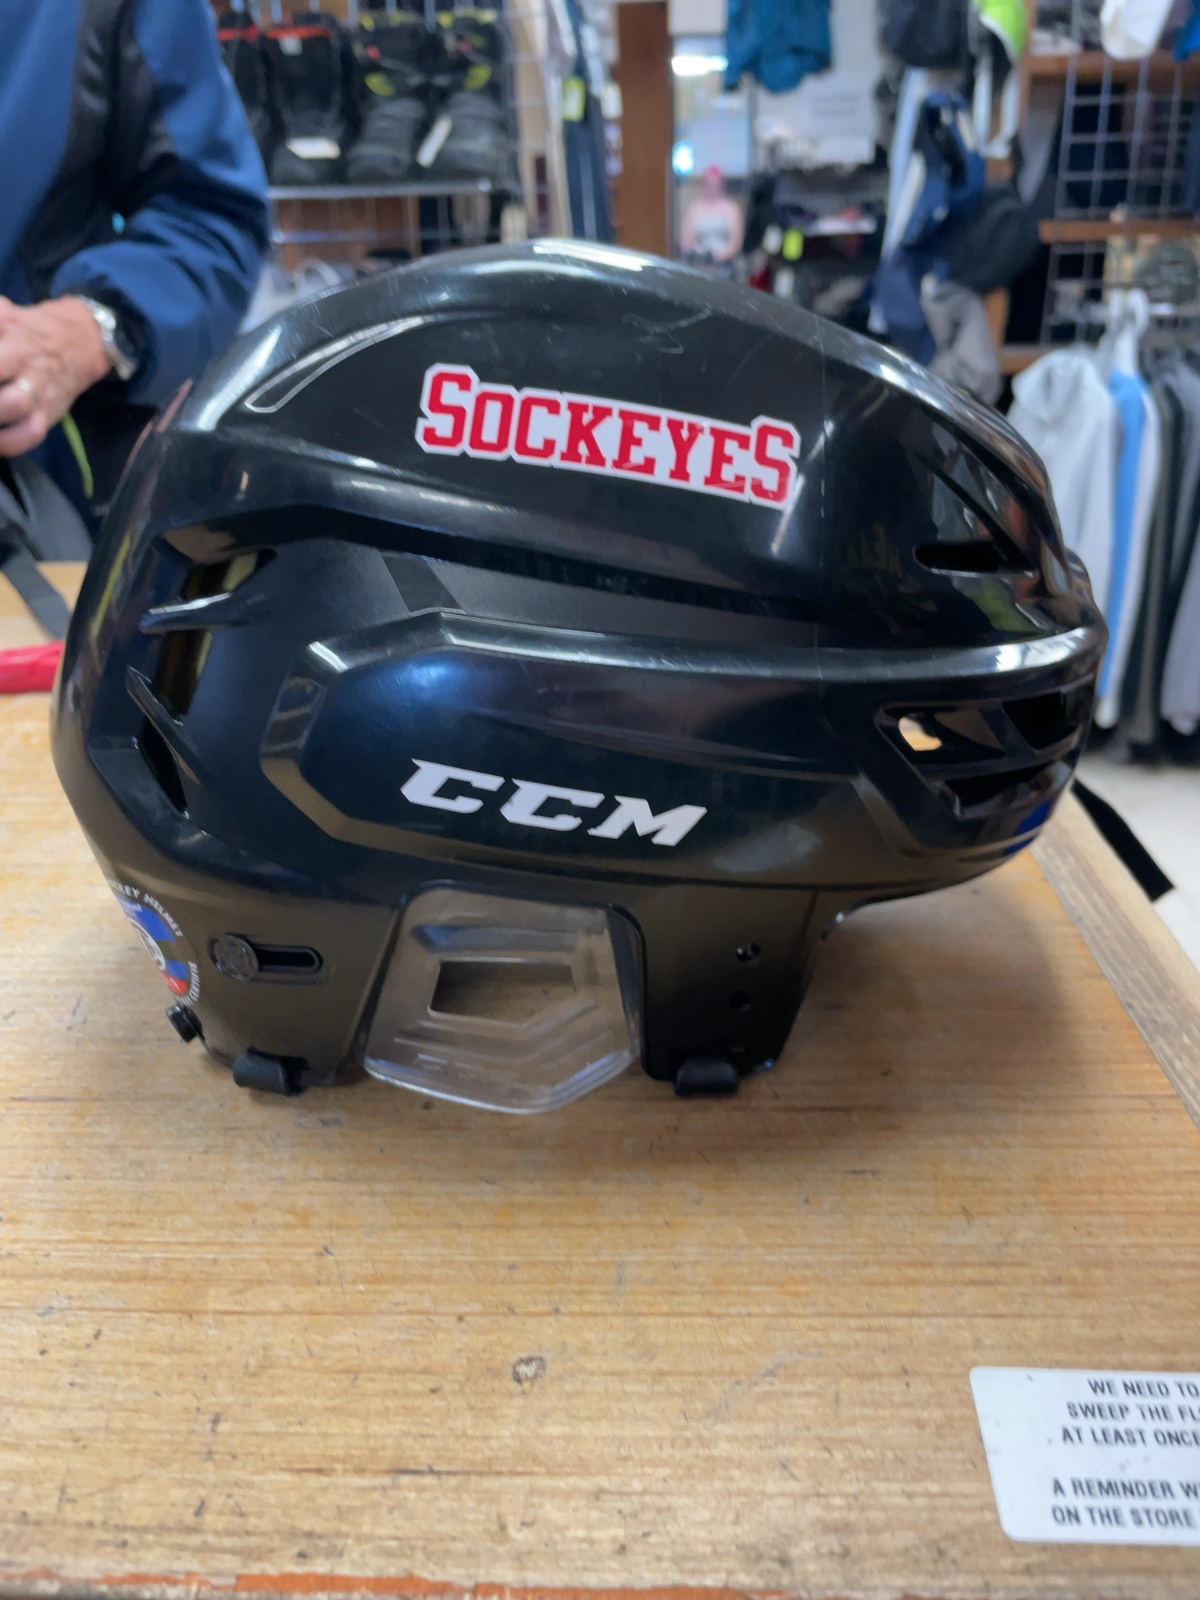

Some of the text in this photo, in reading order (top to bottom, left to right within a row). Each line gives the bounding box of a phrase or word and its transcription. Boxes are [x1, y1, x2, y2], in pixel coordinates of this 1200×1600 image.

[417, 365, 798, 507] SOCKEYES
[400, 758, 708, 847] CCM
[143, 892, 184, 937] HELMET
[1087, 1378, 1200, 1399] WE NEED TO
[1066, 1401, 1200, 1423] SWEEP THE FL
[1061, 1425, 1200, 1448] AT LEAST ONCE
[1053, 1477, 1065, 1498] A
[1070, 1477, 1175, 1498] REMINDER
[1051, 1505, 1198, 1529] ON THE STORE
